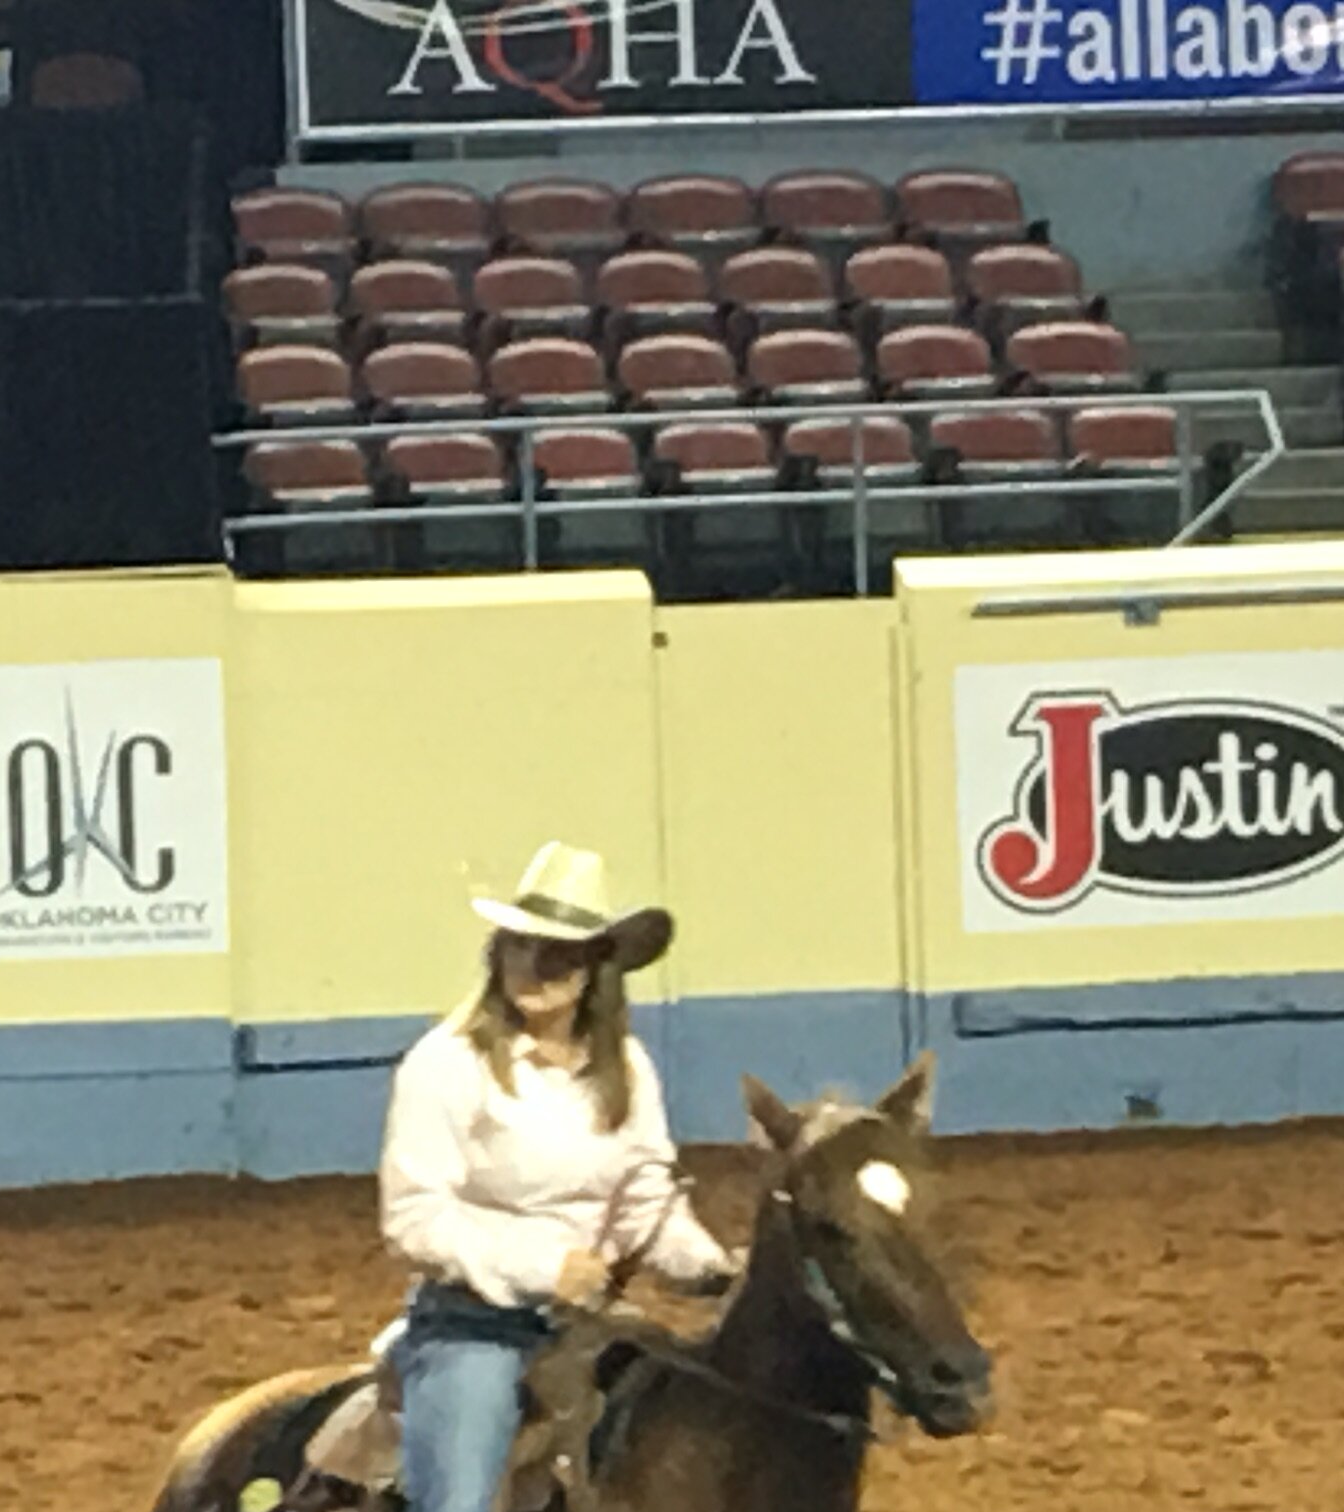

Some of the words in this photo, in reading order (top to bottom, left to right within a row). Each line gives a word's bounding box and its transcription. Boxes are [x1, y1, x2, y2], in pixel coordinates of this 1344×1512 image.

[389, 0, 816, 112] AQHA
[989, 703, 1344, 901] Justin
[147, 903, 208, 924] CITY
